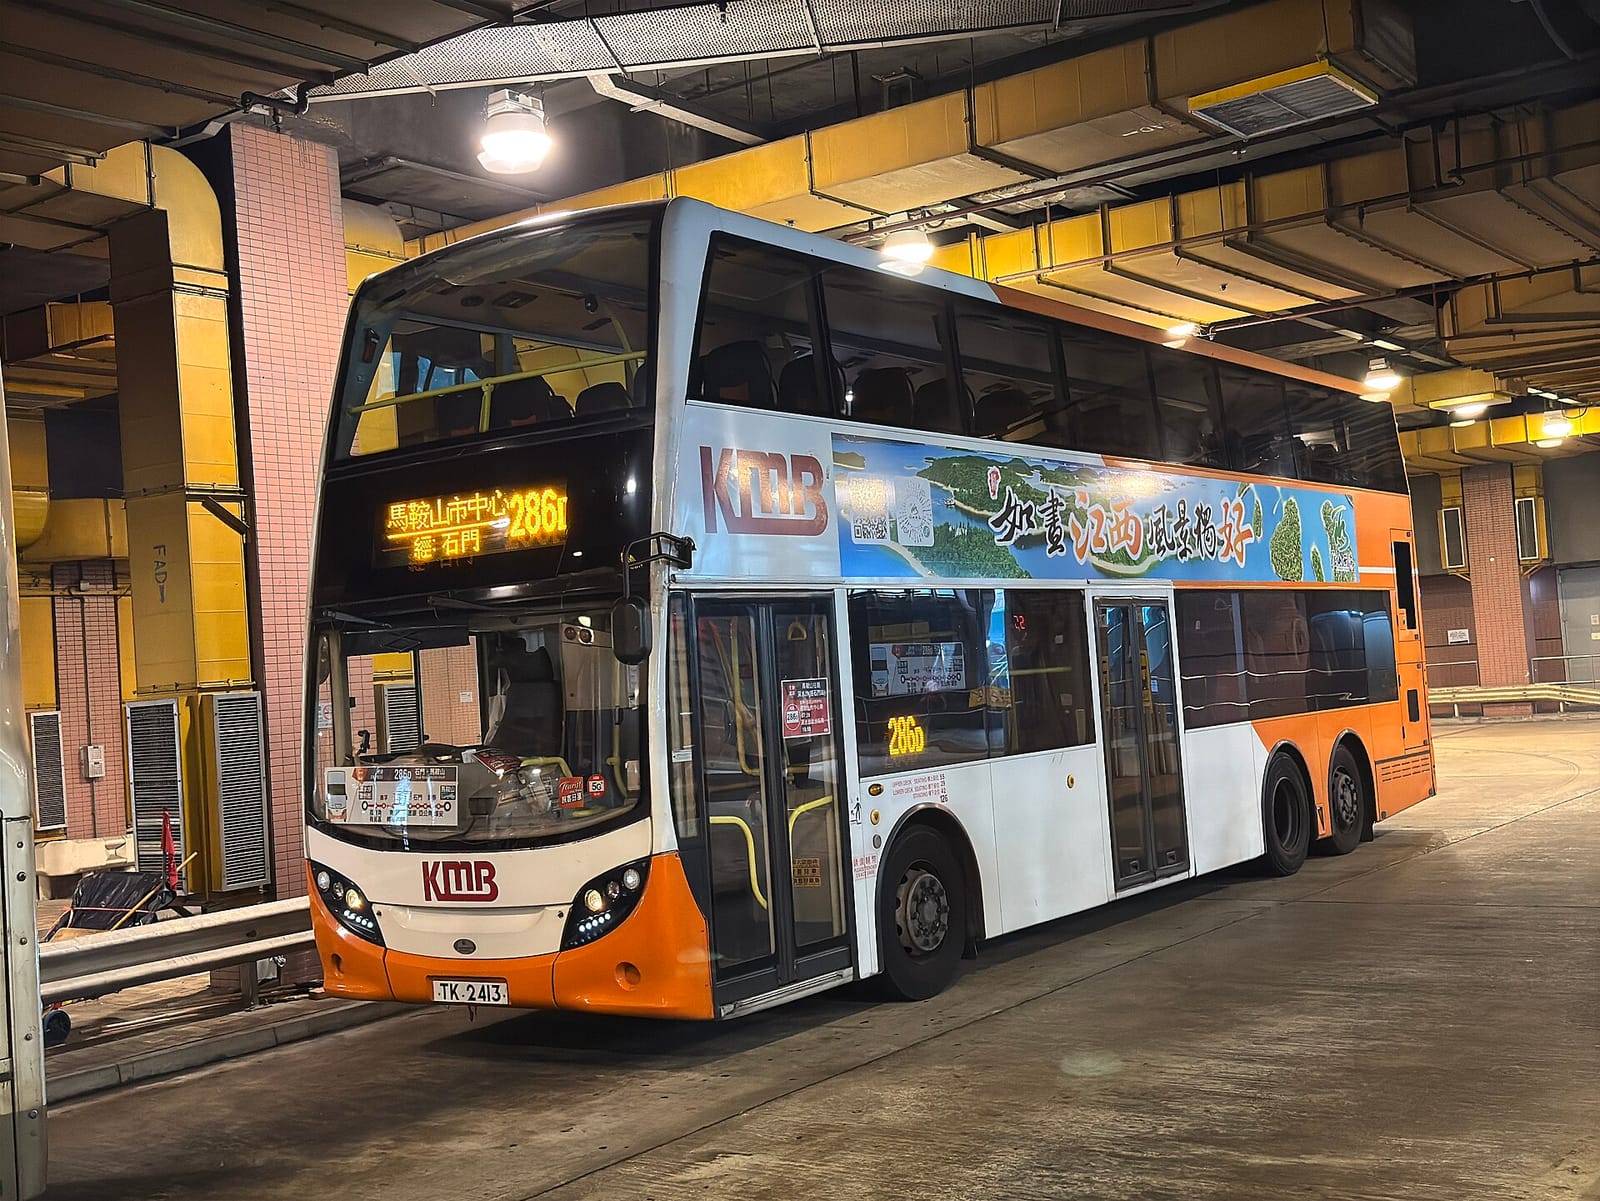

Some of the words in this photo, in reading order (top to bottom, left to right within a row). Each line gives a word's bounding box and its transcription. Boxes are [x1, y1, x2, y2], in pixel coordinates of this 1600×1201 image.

[699, 445, 829, 535] KMB
[387, 490, 510, 532] 馬鞍山市中心
[441, 528, 480, 556] 石門
[153, 544, 168, 584] FAD
[888, 715, 925, 756] 286D
[421, 860, 499, 902] KMB
[439, 982, 459, 1000] TK
[466, 984, 502, 1002] 2413
